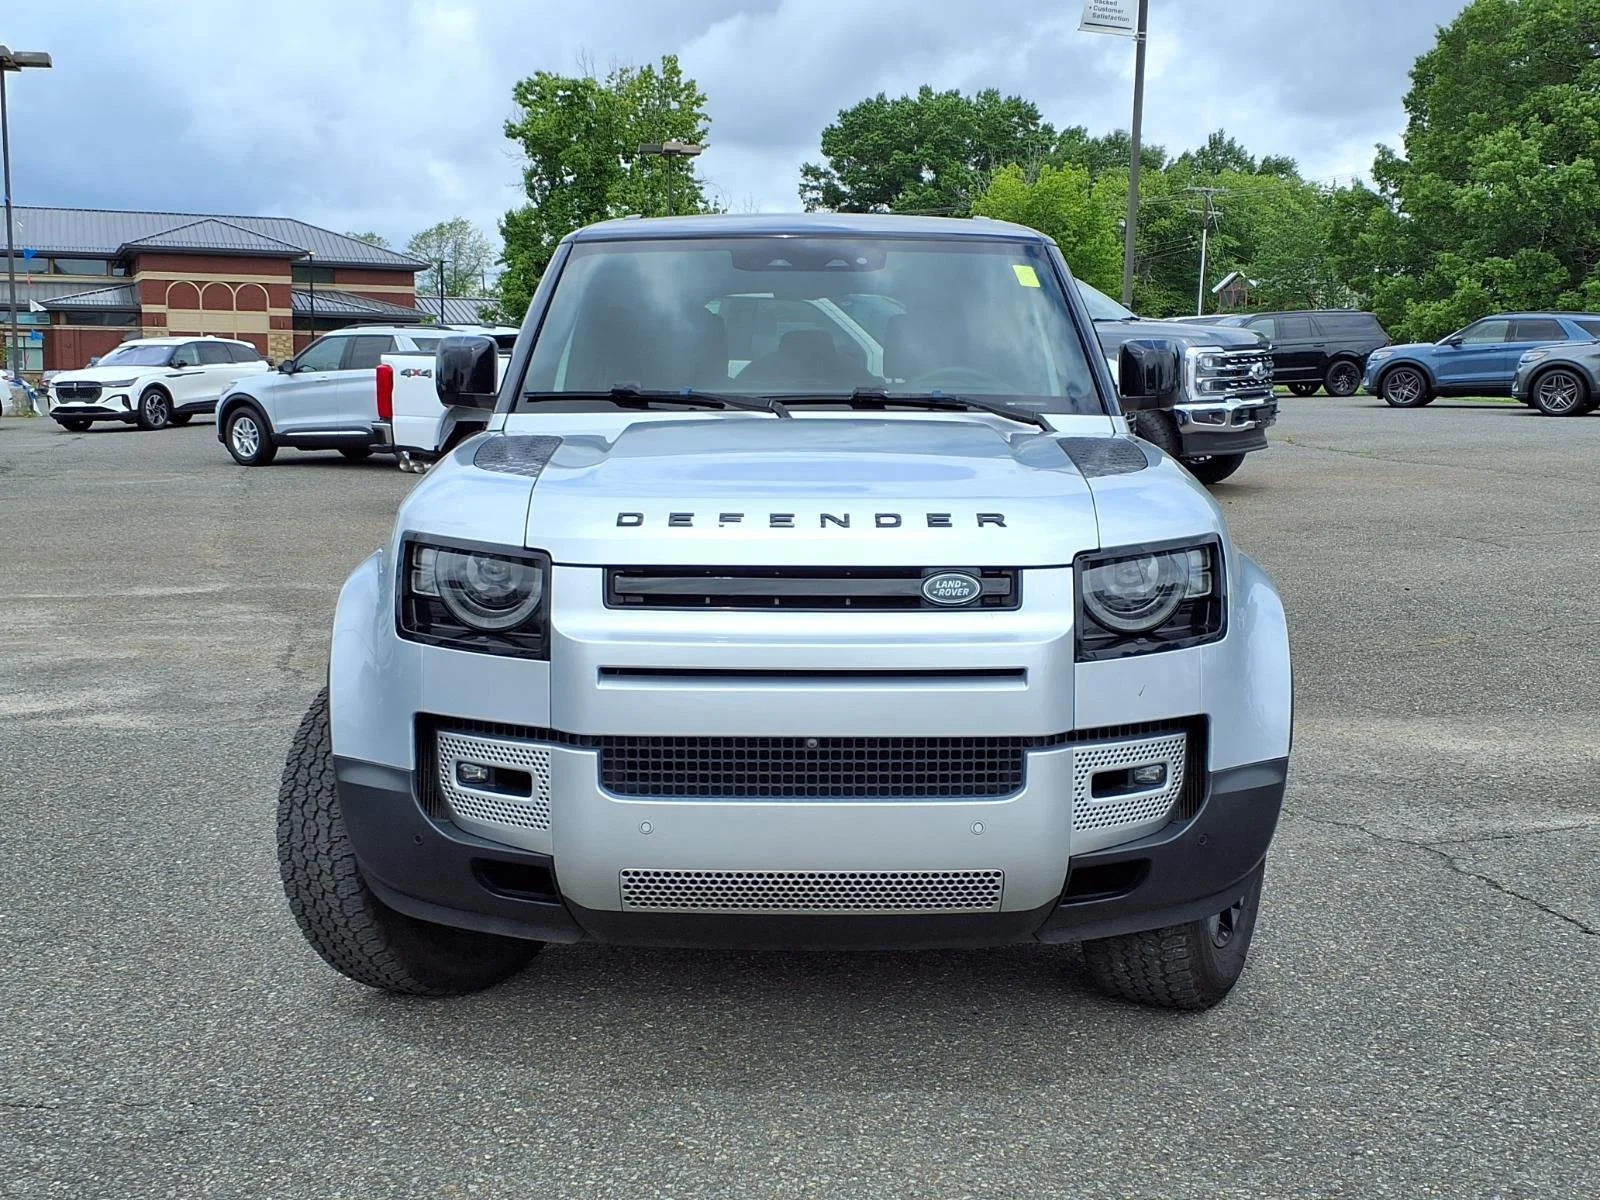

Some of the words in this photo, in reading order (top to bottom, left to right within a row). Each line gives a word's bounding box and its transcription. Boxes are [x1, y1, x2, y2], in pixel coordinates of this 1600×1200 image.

[1093, 5, 1124, 14] Customer
[1092, 12, 1130, 23] Satisfaction
[616, 512, 1008, 528] DEFENDER
